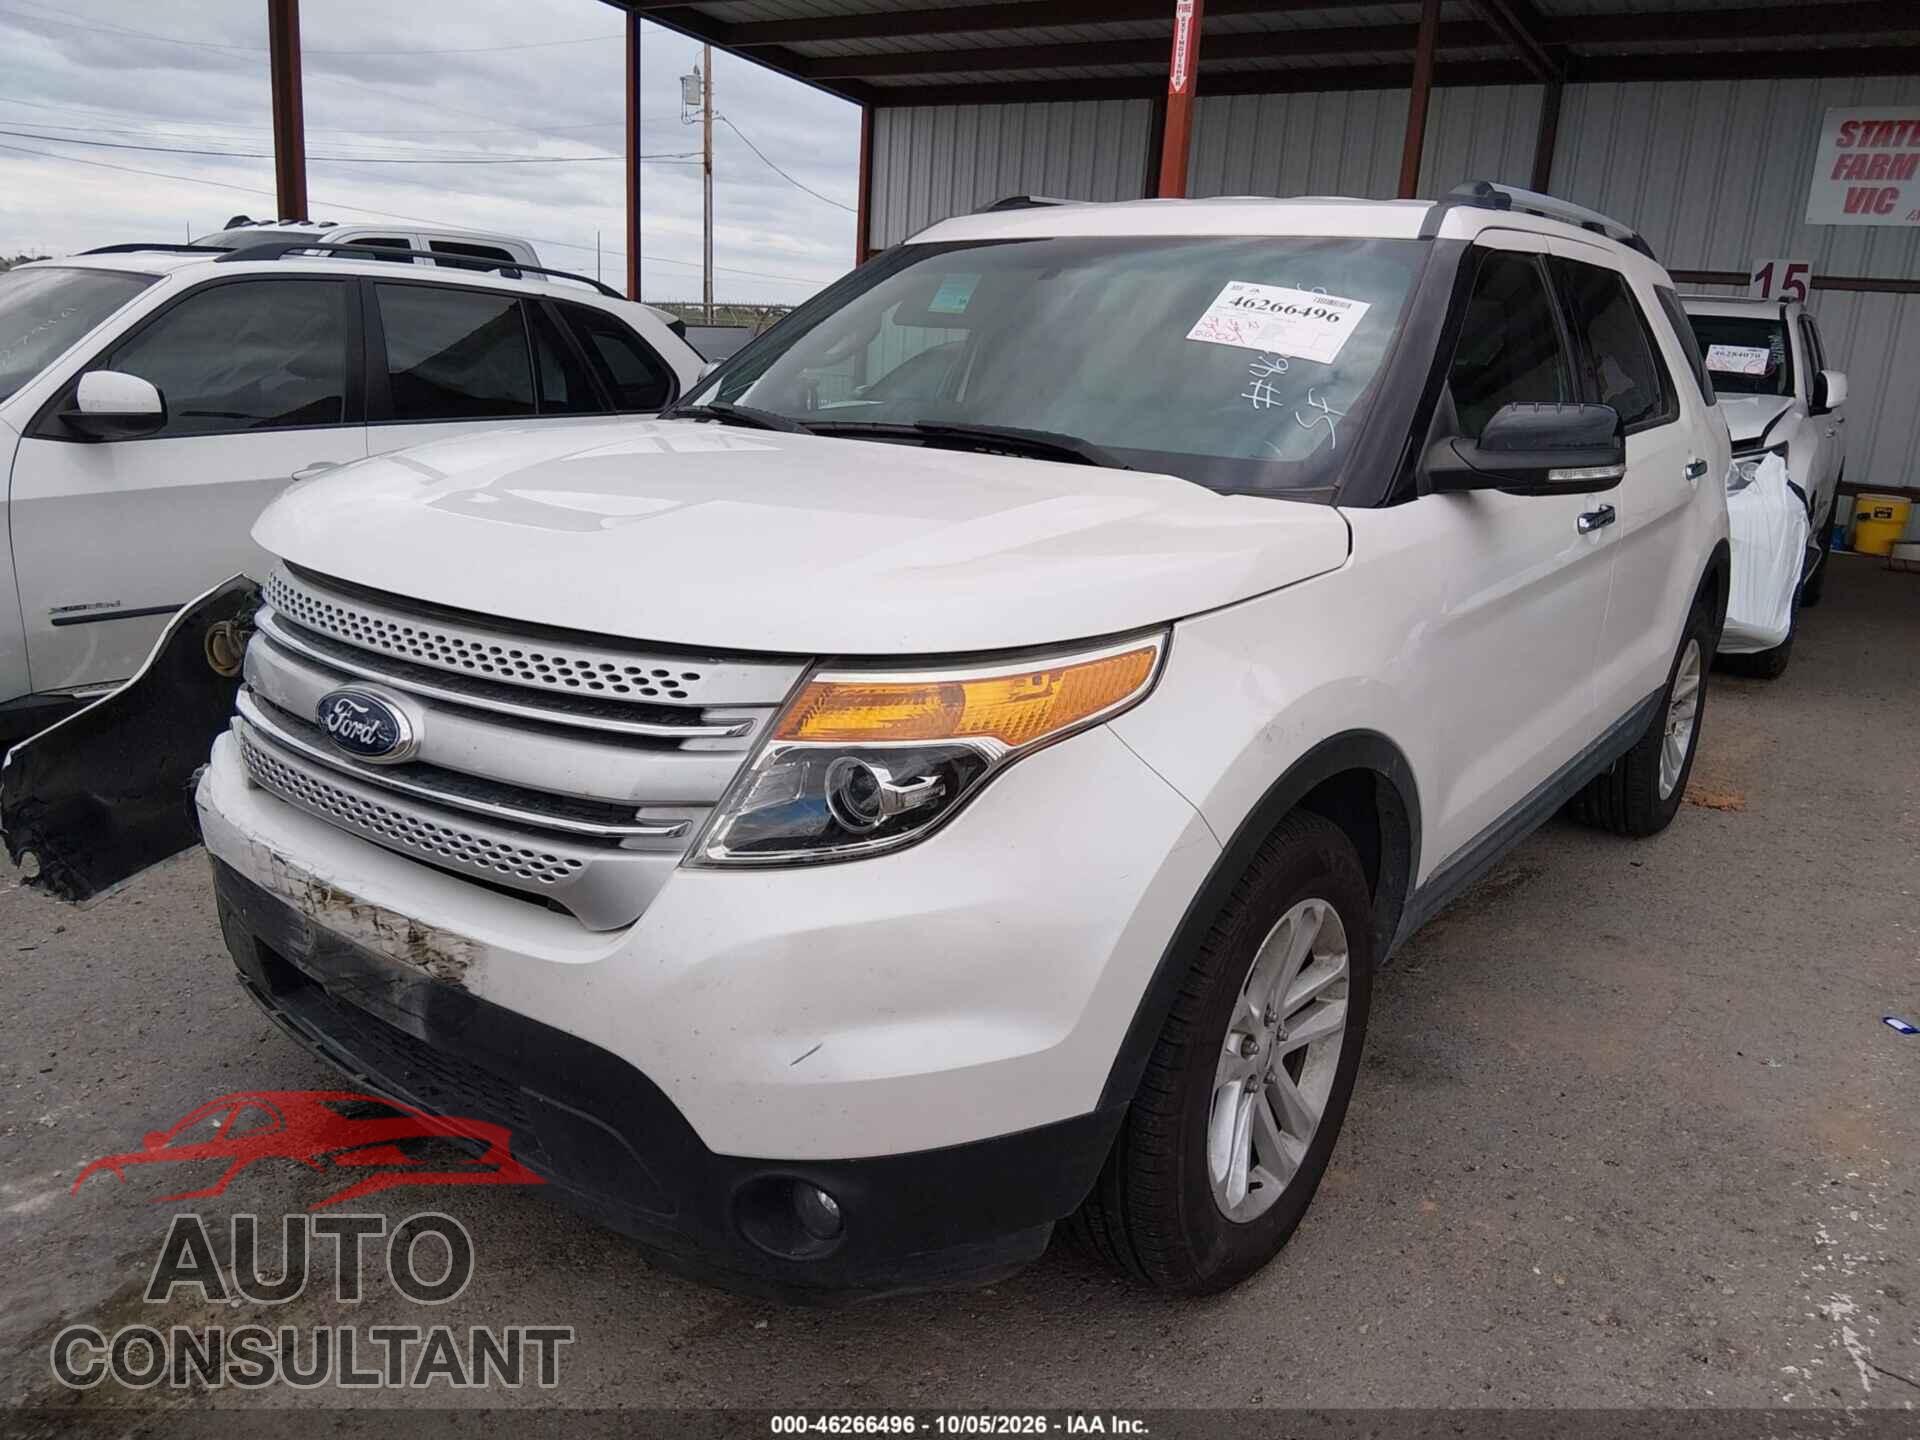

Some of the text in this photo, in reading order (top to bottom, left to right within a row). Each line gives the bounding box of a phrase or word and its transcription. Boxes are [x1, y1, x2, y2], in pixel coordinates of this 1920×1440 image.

[1830, 152, 1920, 181] FARM
[1842, 186, 1900, 215] VIC
[1754, 261, 1809, 304] 15
[1228, 295, 1341, 323] 46266496
[327, 698, 386, 745] Ford
